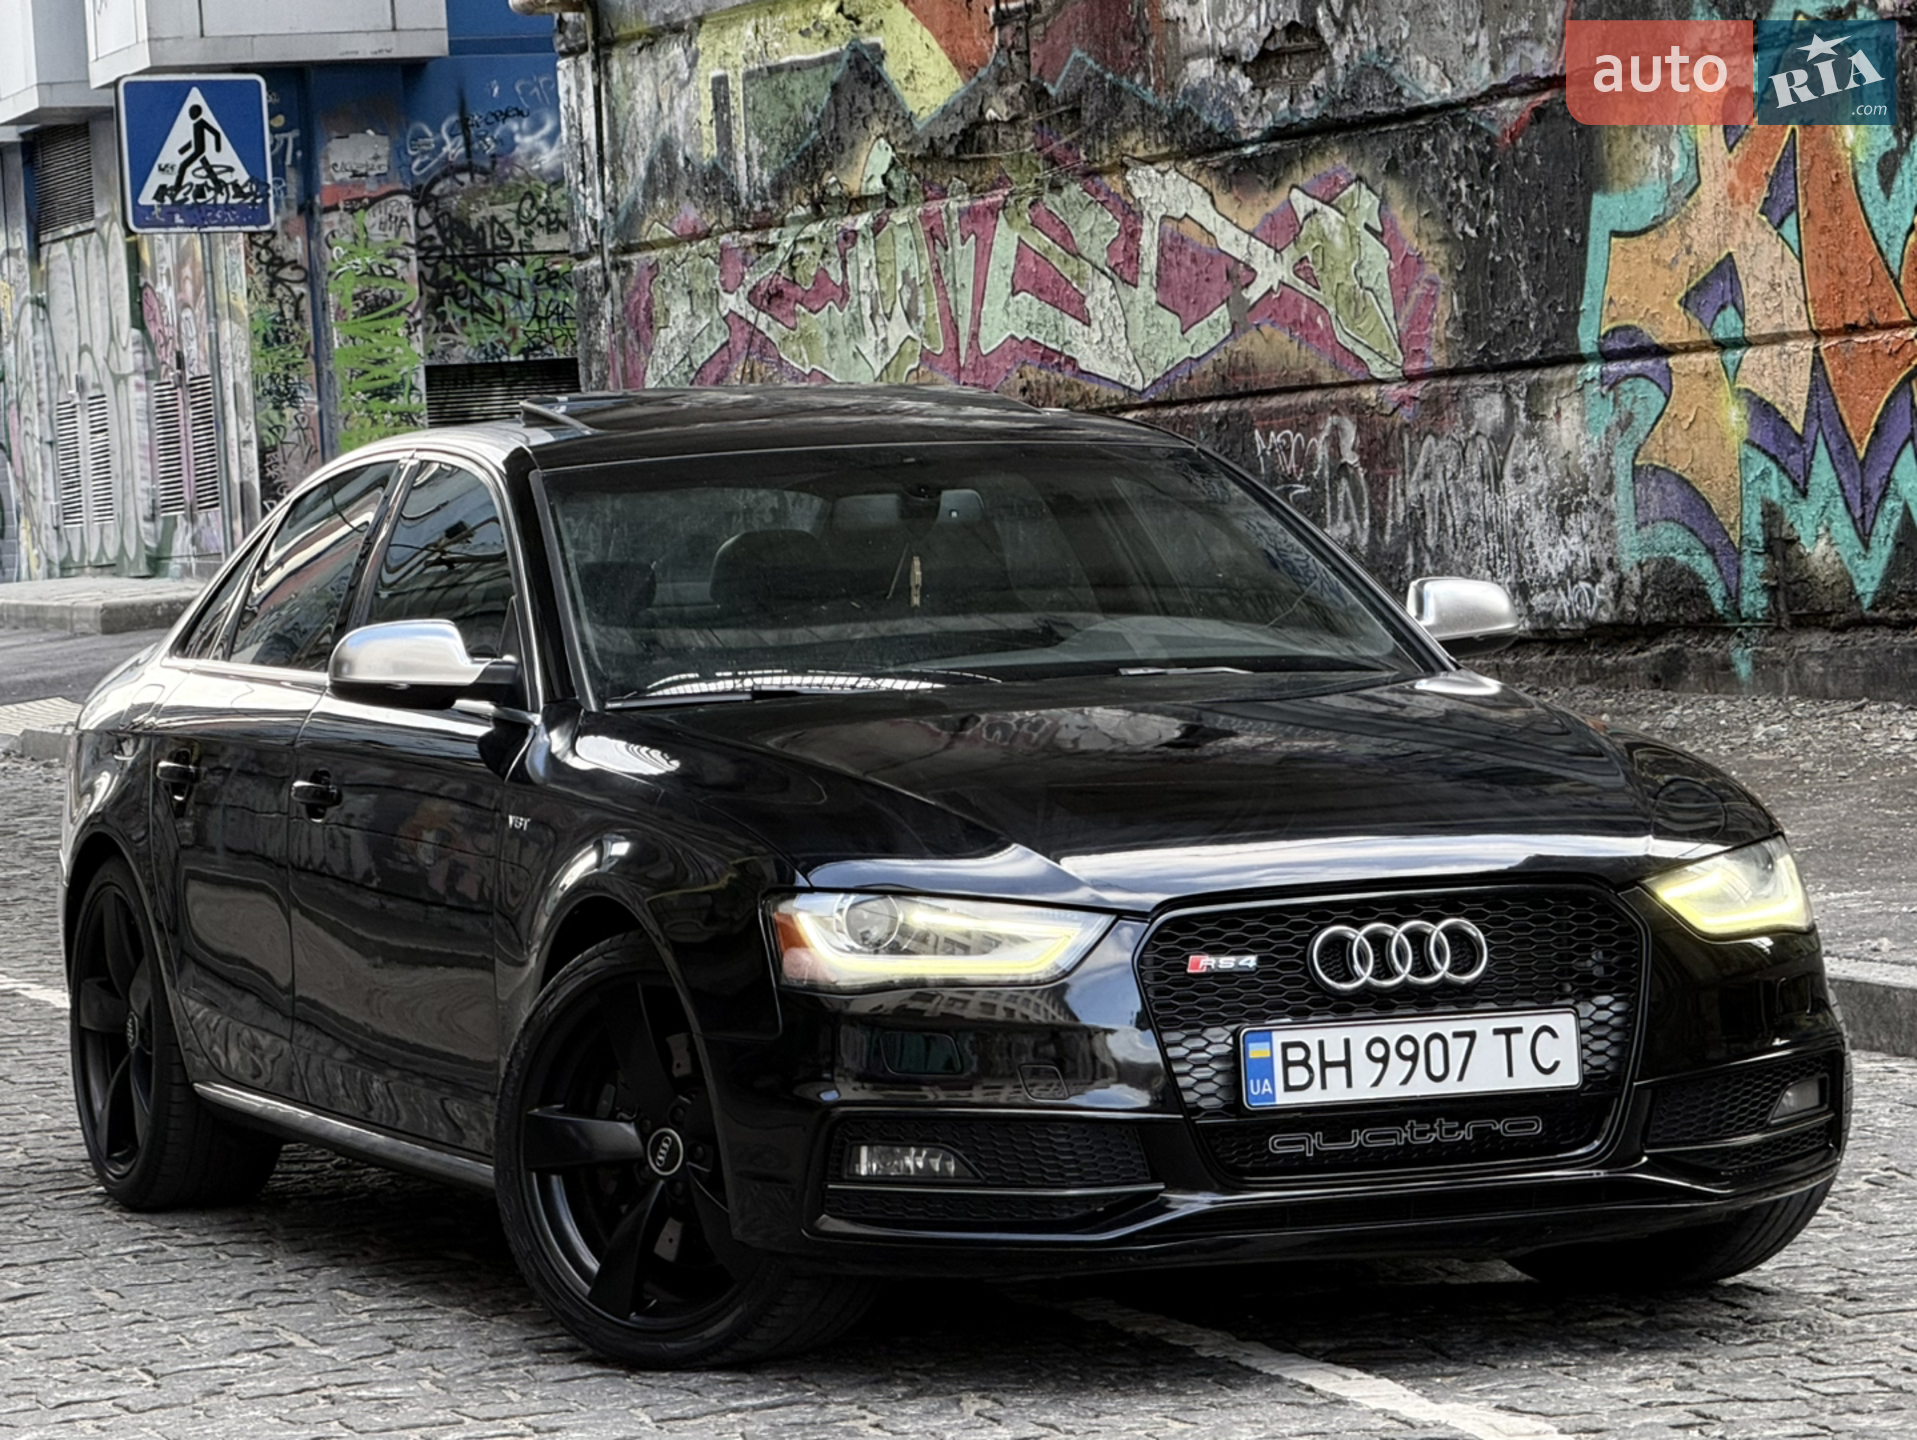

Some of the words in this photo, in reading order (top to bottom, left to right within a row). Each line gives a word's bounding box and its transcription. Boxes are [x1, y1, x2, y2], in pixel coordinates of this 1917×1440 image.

[1199, 955, 1258, 970] RS4
[1280, 1037, 1353, 1093] BH
[1364, 1030, 1477, 1088] 9907
[1492, 1024, 1561, 1079] TC
[1249, 1078, 1273, 1096] UA
[1268, 1116, 1543, 1157] quattro
